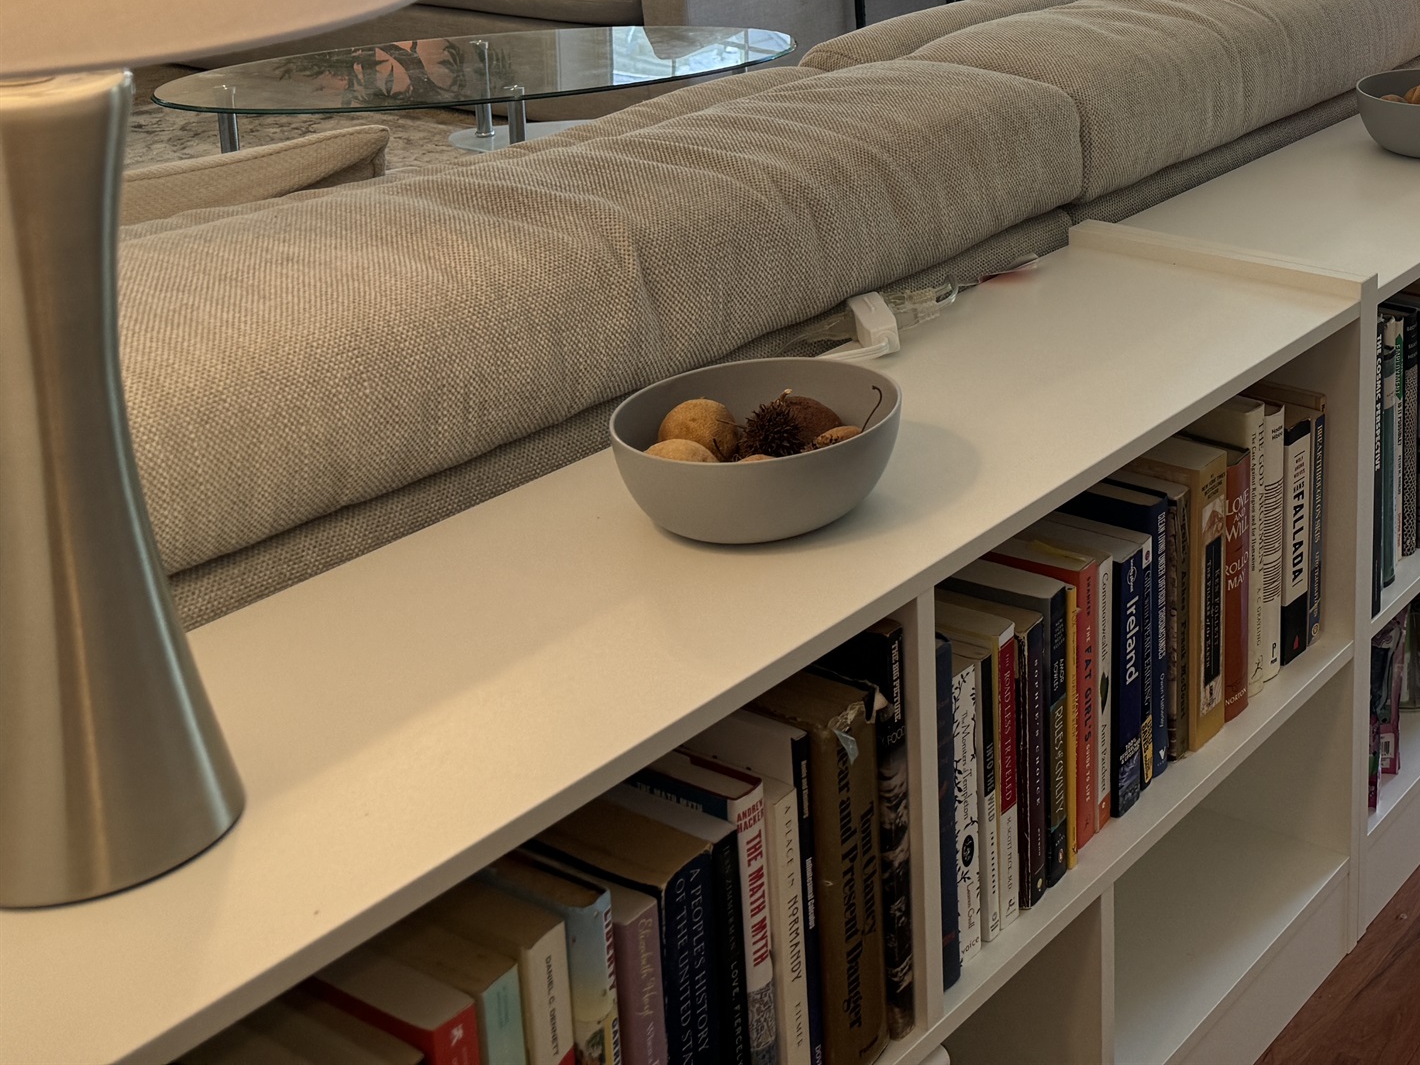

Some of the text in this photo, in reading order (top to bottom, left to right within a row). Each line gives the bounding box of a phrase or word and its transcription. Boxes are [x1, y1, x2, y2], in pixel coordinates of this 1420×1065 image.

[1374, 401, 1382, 471] PERSPECTIVE
[1226, 488, 1249, 515] LOVE
[1294, 481, 1304, 493] HANS
[1226, 515, 1249, 543] WILL
[1233, 507, 1246, 524] AND
[1316, 505, 1320, 519] ON
[1292, 489, 1304, 583] FALLADA
[1226, 551, 1249, 576] ROLLO
[1228, 568, 1246, 591] MAY
[1101, 572, 1109, 662] Commonwealth
[891, 641, 899, 664] THE
[1126, 595, 1139, 685] Ireland
[892, 661, 900, 681] BIG
[1004, 670, 1012, 703] ROAD
[1084, 687, 1092, 742] GIRL'S
[1226, 687, 1247, 705] NORTON
[1004, 703, 1012, 735] LESS
[1054, 705, 1064, 751] RULES
[961, 725, 970, 767] Monsters
[986, 743, 994, 770] INTO
[986, 769, 995, 793] THE
[1004, 737, 1013, 801] TRAVELED
[1055, 759, 1064, 814] CIVILITY
[654, 788, 678, 803] MATH
[680, 797, 703, 812] MYTH
[737, 799, 764, 823] ANDREW
[960, 769, 973, 821] Templeton
[987, 793, 995, 823] WILD
[737, 809, 764, 833] HACKER
[785, 819, 794, 867] PLACE
[860, 801, 876, 936] Tom Clancy
[674, 879, 685, 903] OF
[746, 829, 770, 967] THE MATH MYTH
[676, 907, 688, 951] THE
[839, 799, 864, 1030] and Present Danger
[638, 919, 655, 981] Elizabeth
[787, 895, 802, 983] NORMANDY
[961, 936, 980, 955] voice
[545, 954, 554, 995] DANIEL
[690, 868, 710, 1053] A PEOPLE'S HISTORY
[678, 953, 692, 1027] UNITED
[730, 961, 740, 1001] LOVE,
[549, 1009, 560, 1057] DENNETT
